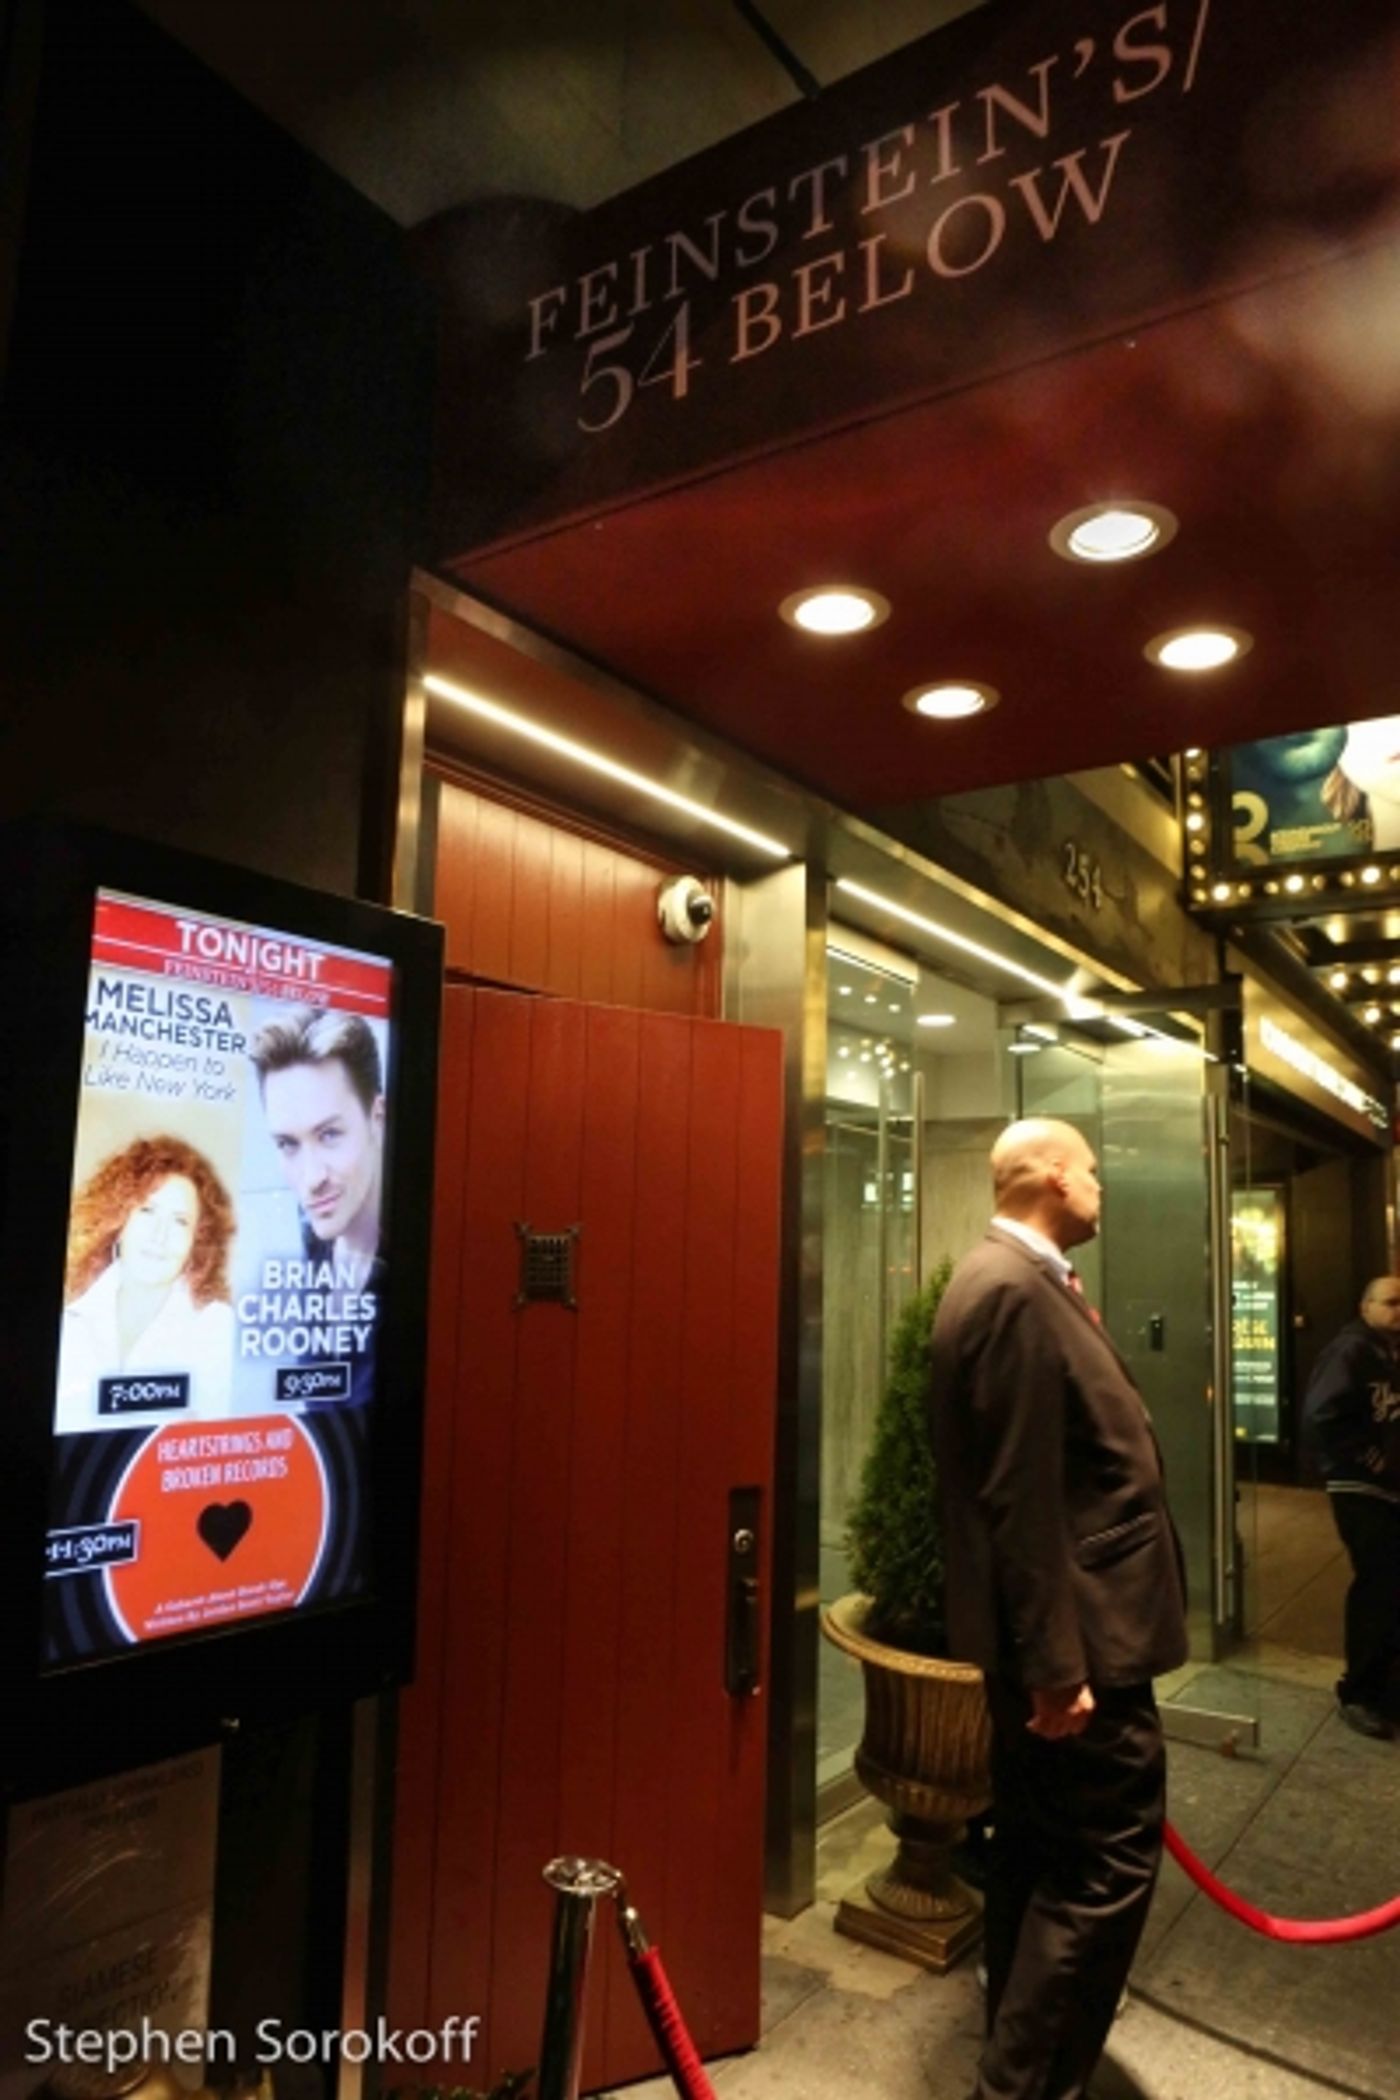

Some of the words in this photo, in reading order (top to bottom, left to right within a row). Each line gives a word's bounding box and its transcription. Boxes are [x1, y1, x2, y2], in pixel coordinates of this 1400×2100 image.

[525, 1, 1210, 361] FEINSTEIN'S/
[577, 304, 701, 433] 54
[728, 131, 1132, 366] BELOW
[178, 921, 324, 979] TONIGHT
[97, 977, 233, 1029] MELISSA
[84, 1011, 247, 1053] MANCHESTER
[112, 1042, 197, 1074] Happen
[202, 1057, 226, 1077] to
[84, 1064, 131, 1090] Like
[136, 1070, 187, 1097] New
[192, 1077, 237, 1101] York
[262, 1260, 356, 1290] BRIAN
[236, 1292, 377, 1324] CHARLES
[241, 1326, 371, 1357] ROONEY
[108, 1381, 181, 1410] 7:00PM
[224, 1456, 289, 1485] RECORDS
